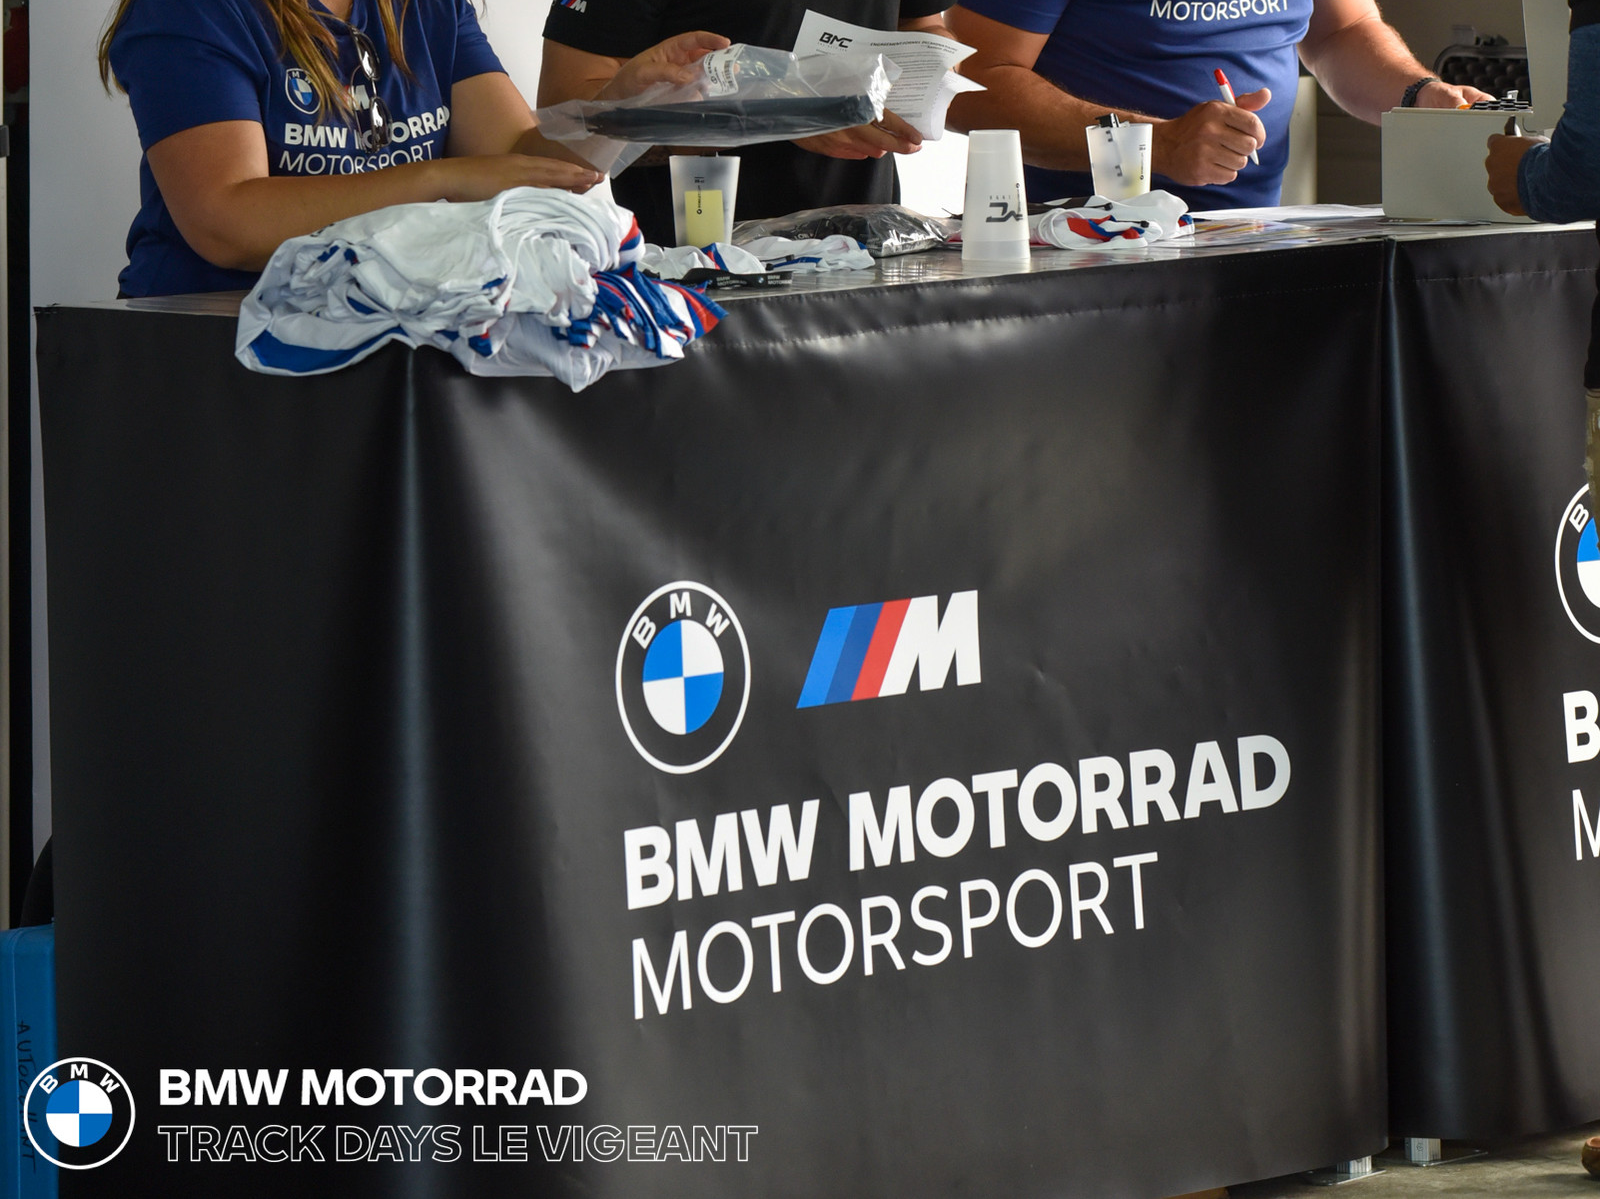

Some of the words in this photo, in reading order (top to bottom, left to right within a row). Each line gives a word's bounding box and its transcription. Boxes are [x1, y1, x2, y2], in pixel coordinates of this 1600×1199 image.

[819, 32, 853, 49] BMC
[278, 140, 435, 176] MOTORSPORT
[284, 123, 348, 149] BMW
[631, 591, 730, 649] BMW
[624, 799, 820, 911] BMW
[848, 734, 1291, 872] MOTORRAD
[632, 852, 1159, 1020] MOTORSPORT
